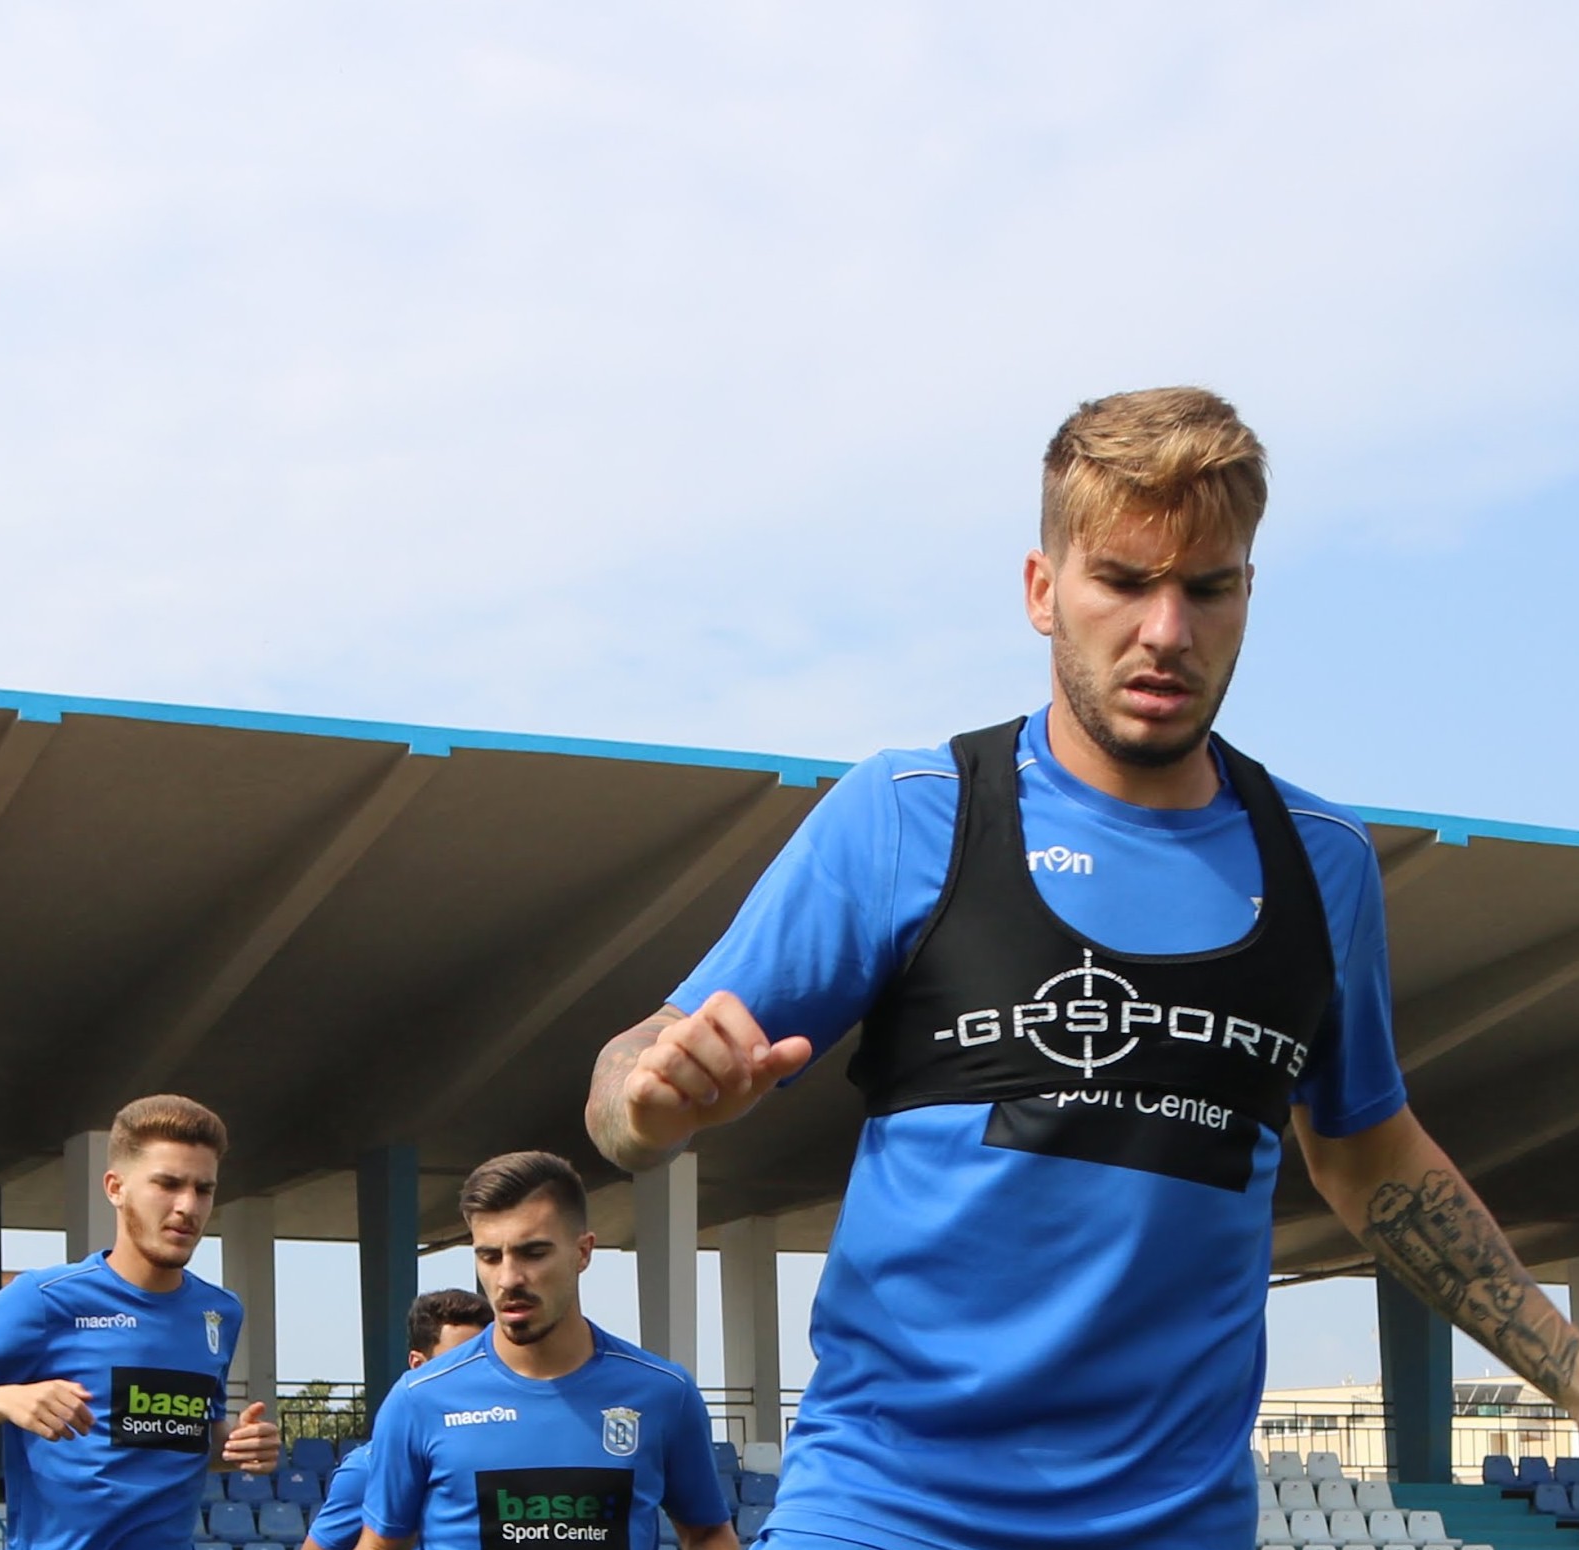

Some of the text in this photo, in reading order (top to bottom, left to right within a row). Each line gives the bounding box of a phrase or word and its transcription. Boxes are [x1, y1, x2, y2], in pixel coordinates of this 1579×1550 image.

[1134, 1091, 1233, 1131] Center
[74, 1312, 138, 1329] macron
[121, 1416, 163, 1435] Sport
[443, 1405, 518, 1428] macron
[501, 1522, 609, 1544] Sport Center
